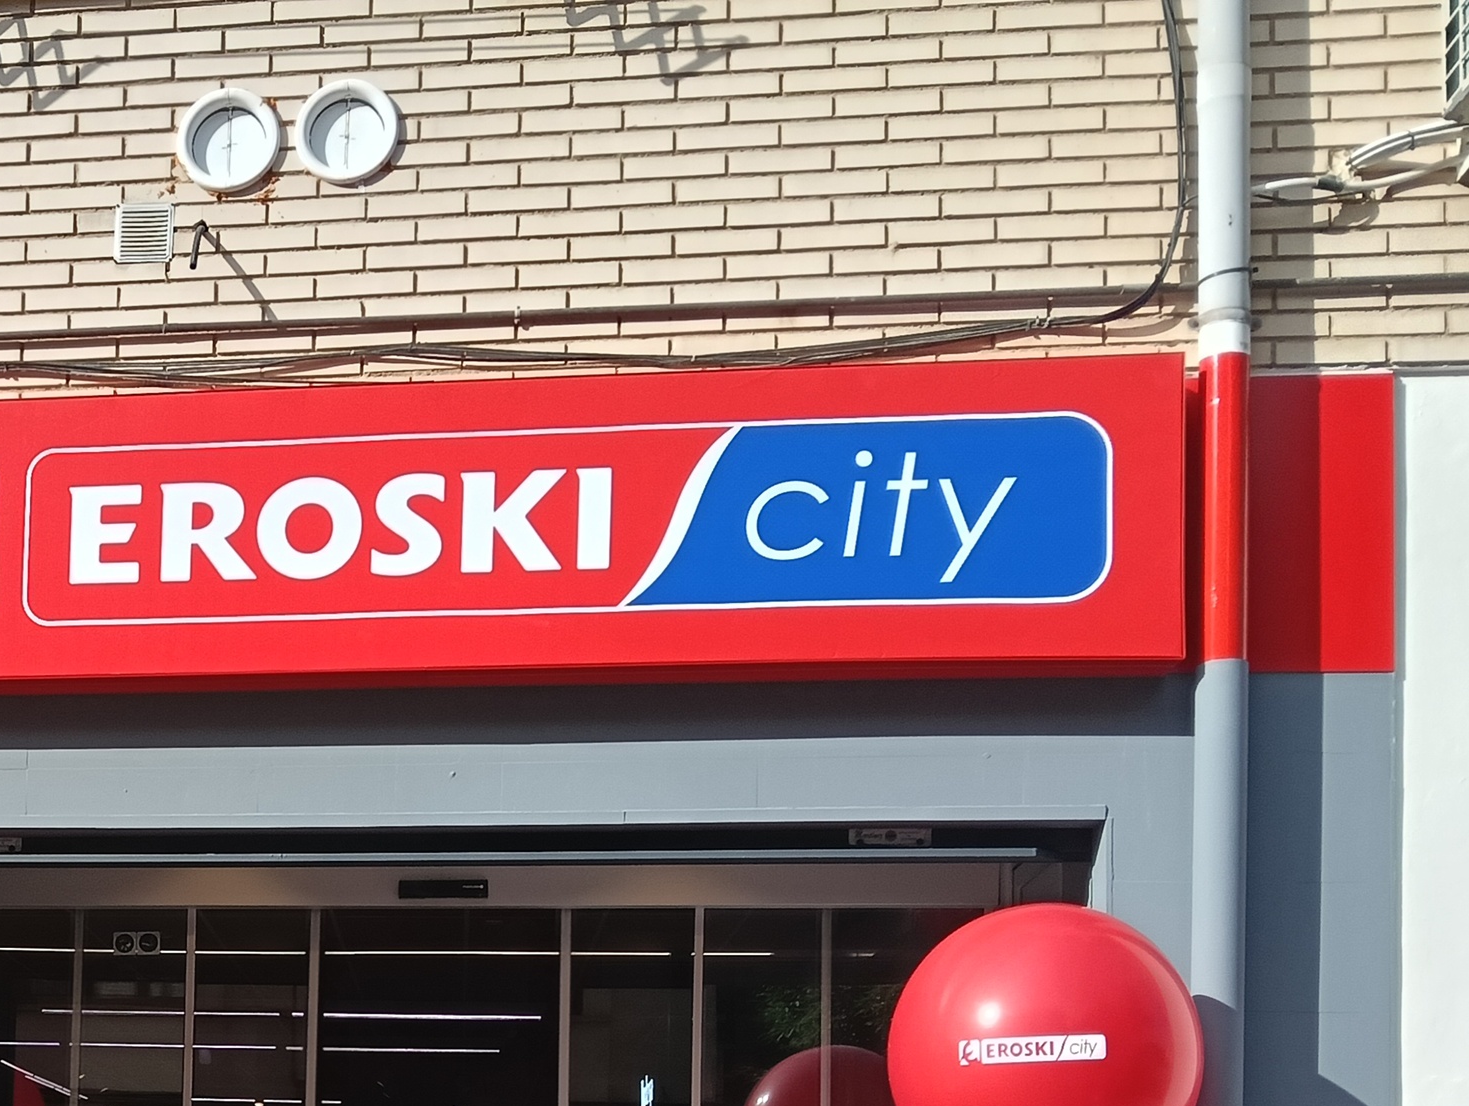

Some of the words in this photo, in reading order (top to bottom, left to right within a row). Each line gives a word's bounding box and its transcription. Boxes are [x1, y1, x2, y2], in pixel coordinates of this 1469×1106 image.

[67, 467, 612, 586] EROSKI
[744, 448, 1017, 583] city
[986, 1041, 1054, 1058] EROSKI
[1069, 1039, 1098, 1058] city
